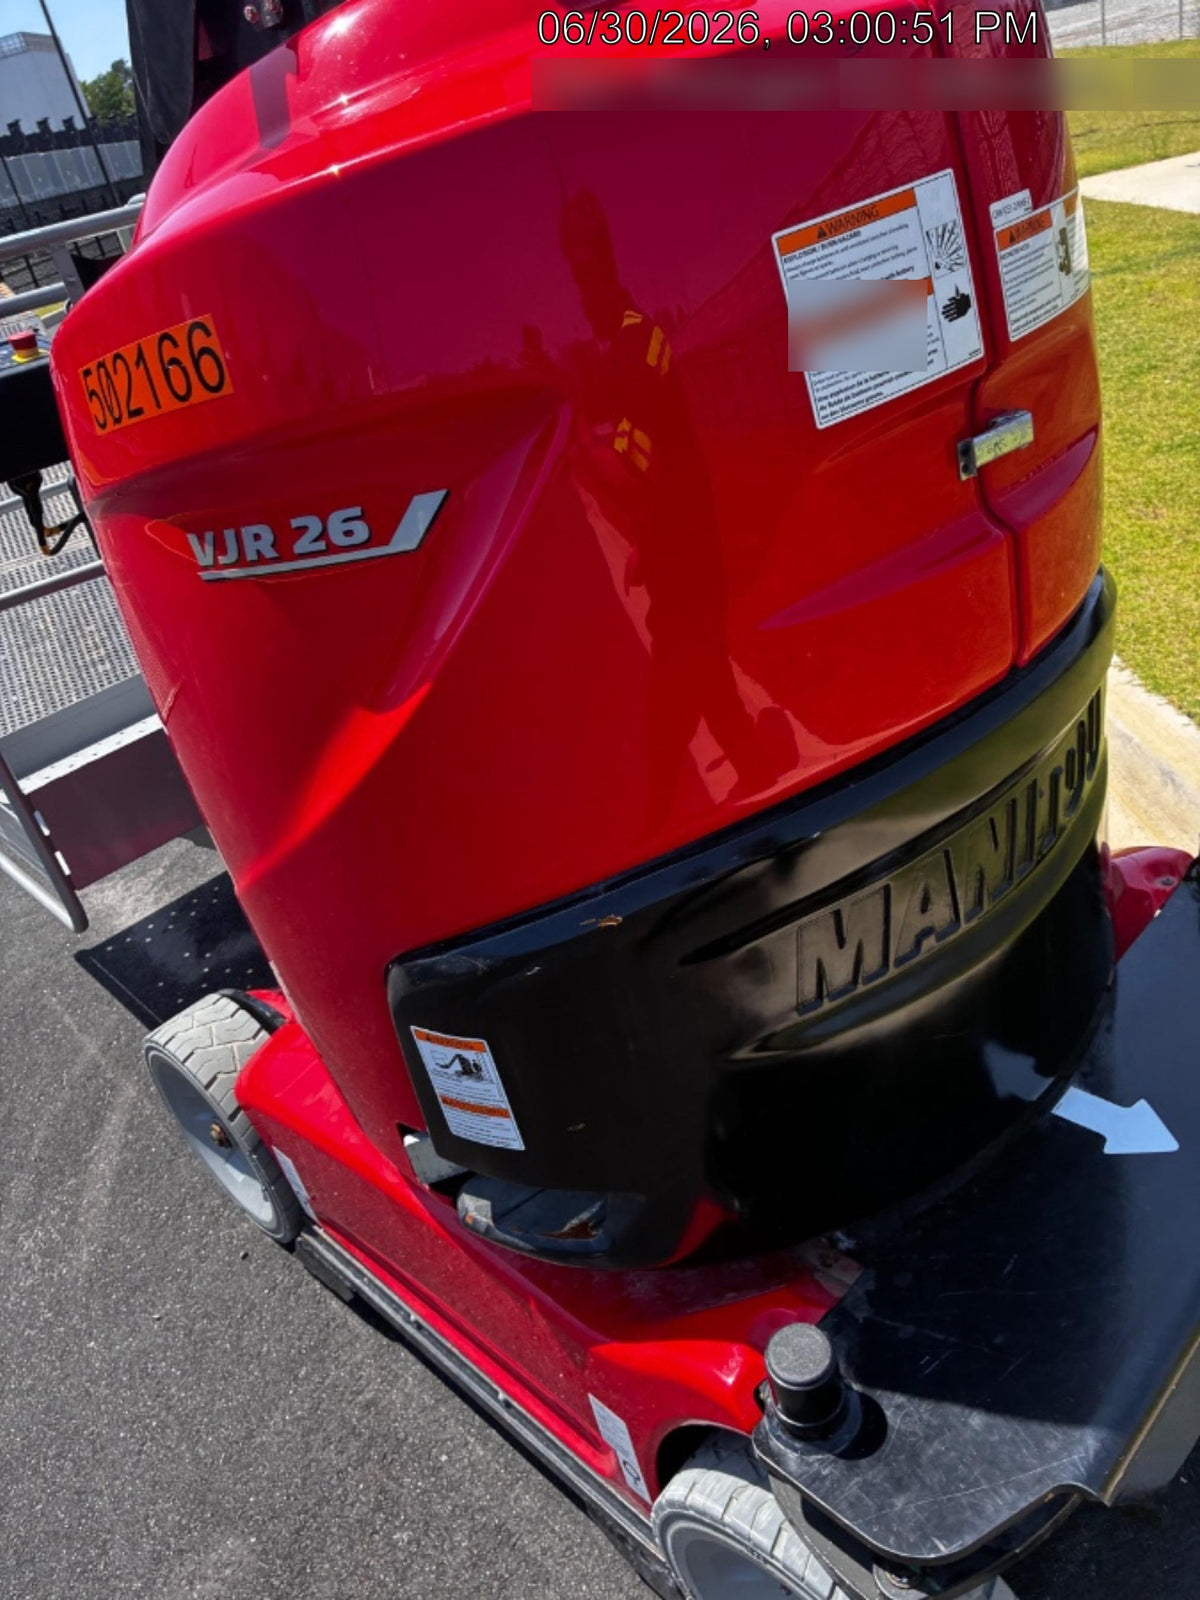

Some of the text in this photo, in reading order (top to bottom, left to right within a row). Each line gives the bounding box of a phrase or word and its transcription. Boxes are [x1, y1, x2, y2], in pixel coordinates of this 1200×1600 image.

[827, 204, 880, 236] WARNING
[83, 320, 227, 430] 502166
[186, 506, 371, 567] VJR 26
[796, 685, 1102, 1016] MANITOU
